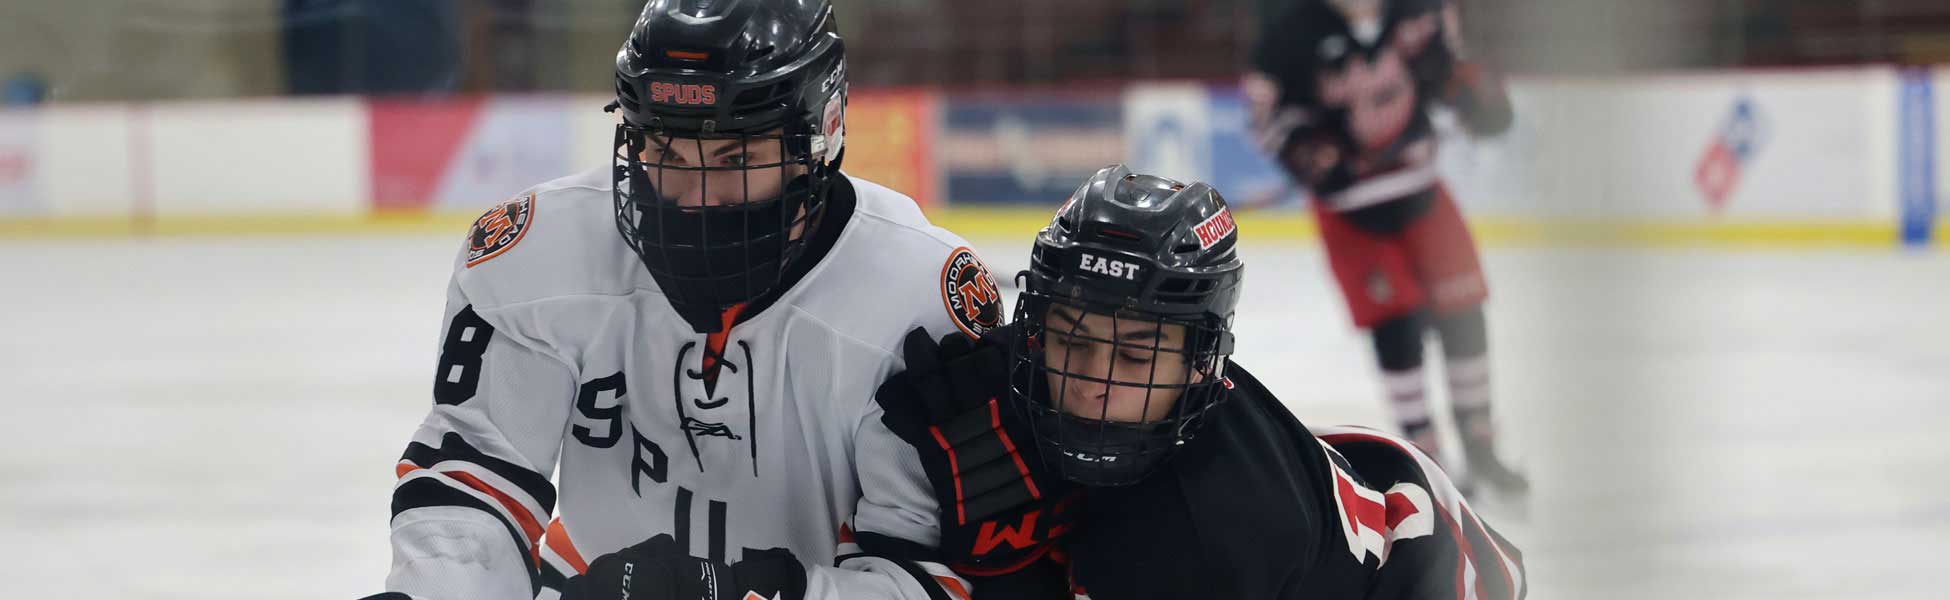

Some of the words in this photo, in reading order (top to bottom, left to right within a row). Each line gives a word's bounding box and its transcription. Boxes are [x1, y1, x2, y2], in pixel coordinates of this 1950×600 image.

[651, 82, 716, 105] SPUDS
[1080, 253, 1140, 280] EAST
[959, 271, 998, 321] M
[433, 303, 495, 406] 8
